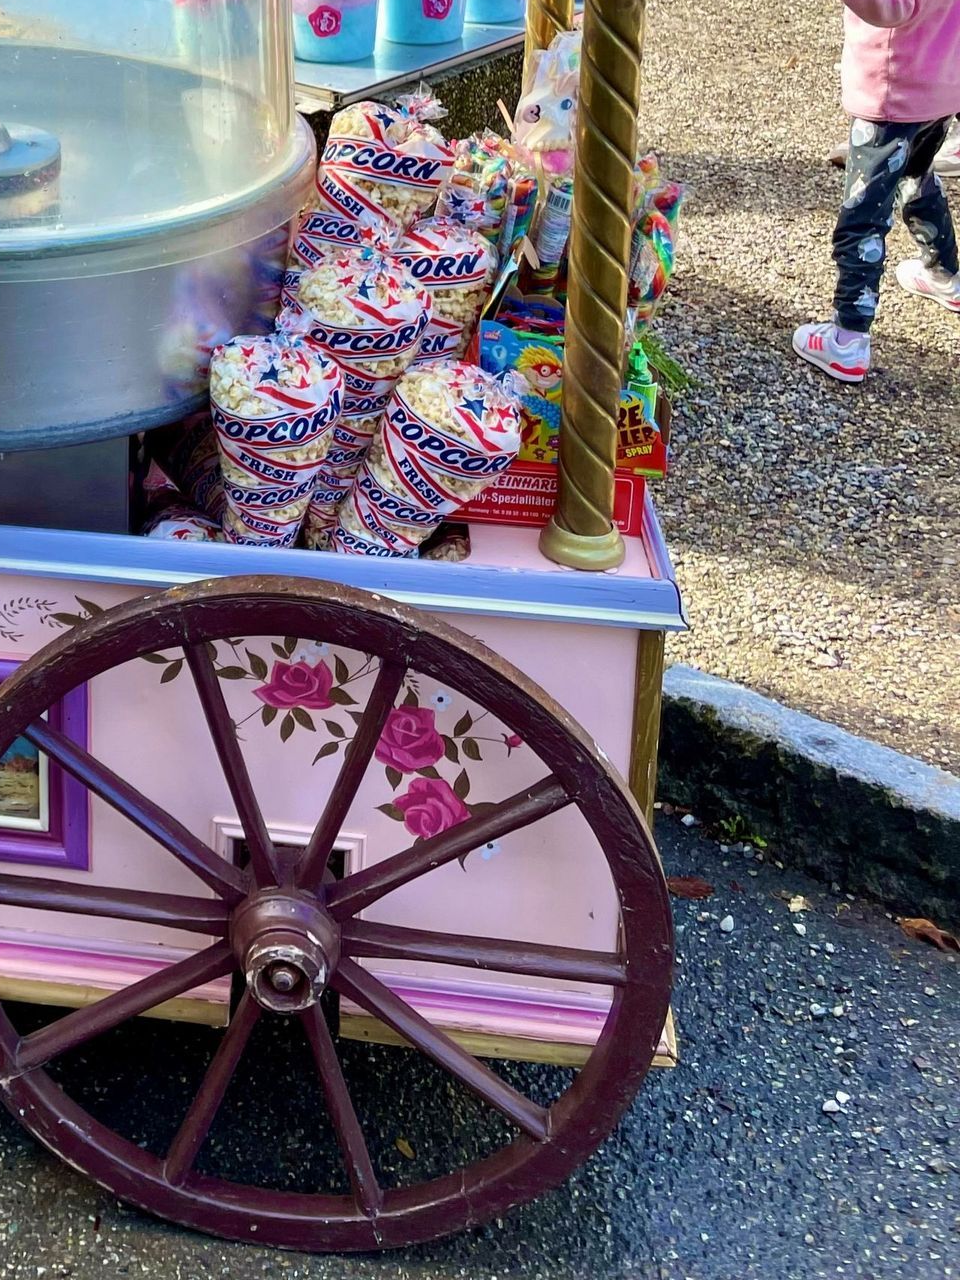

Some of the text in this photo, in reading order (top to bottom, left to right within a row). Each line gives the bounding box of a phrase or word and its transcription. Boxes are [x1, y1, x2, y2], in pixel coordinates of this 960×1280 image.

[323, 144, 441, 180] OPCORN
[321, 176, 365, 216] FRESH
[400, 253, 479, 278] CORN
[311, 309, 429, 352] OPCORN
[344, 372, 376, 391] ESH
[215, 390, 340, 444] POPCORN
[617, 405, 642, 429] RE
[618, 426, 654, 448] LER
[625, 444, 653, 458] SPRAY
[239, 451, 298, 482] FRESH
[398, 456, 445, 507] FRESH
[360, 476, 443, 524] POPCOR
[240, 512, 279, 533] FRESH
[365, 512, 399, 544] FRESH
